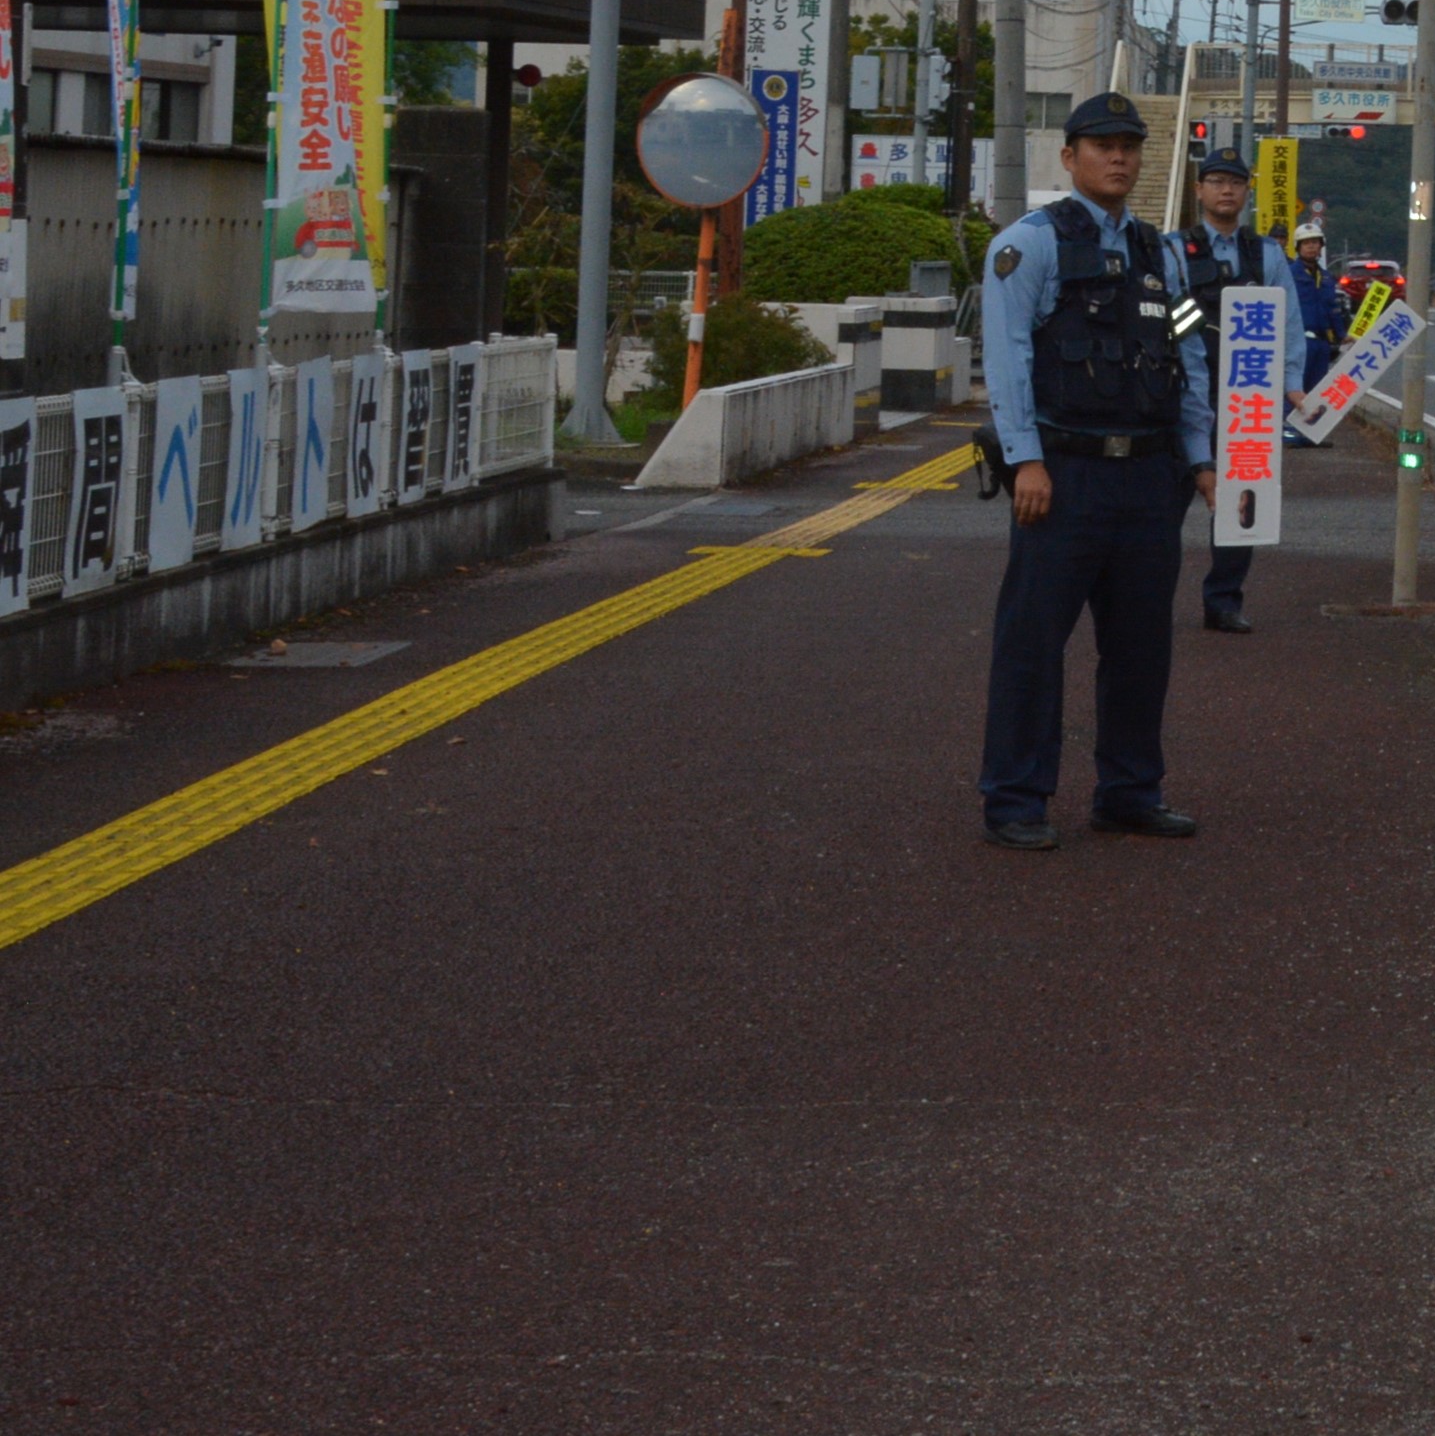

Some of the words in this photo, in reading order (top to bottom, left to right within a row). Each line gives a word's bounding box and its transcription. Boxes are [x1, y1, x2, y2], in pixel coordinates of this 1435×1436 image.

[1318, 91, 1390, 108] 多久市役所
[1225, 300, 1276, 481] 速度注意
[1320, 311, 1415, 411] 全席ベルト着用
